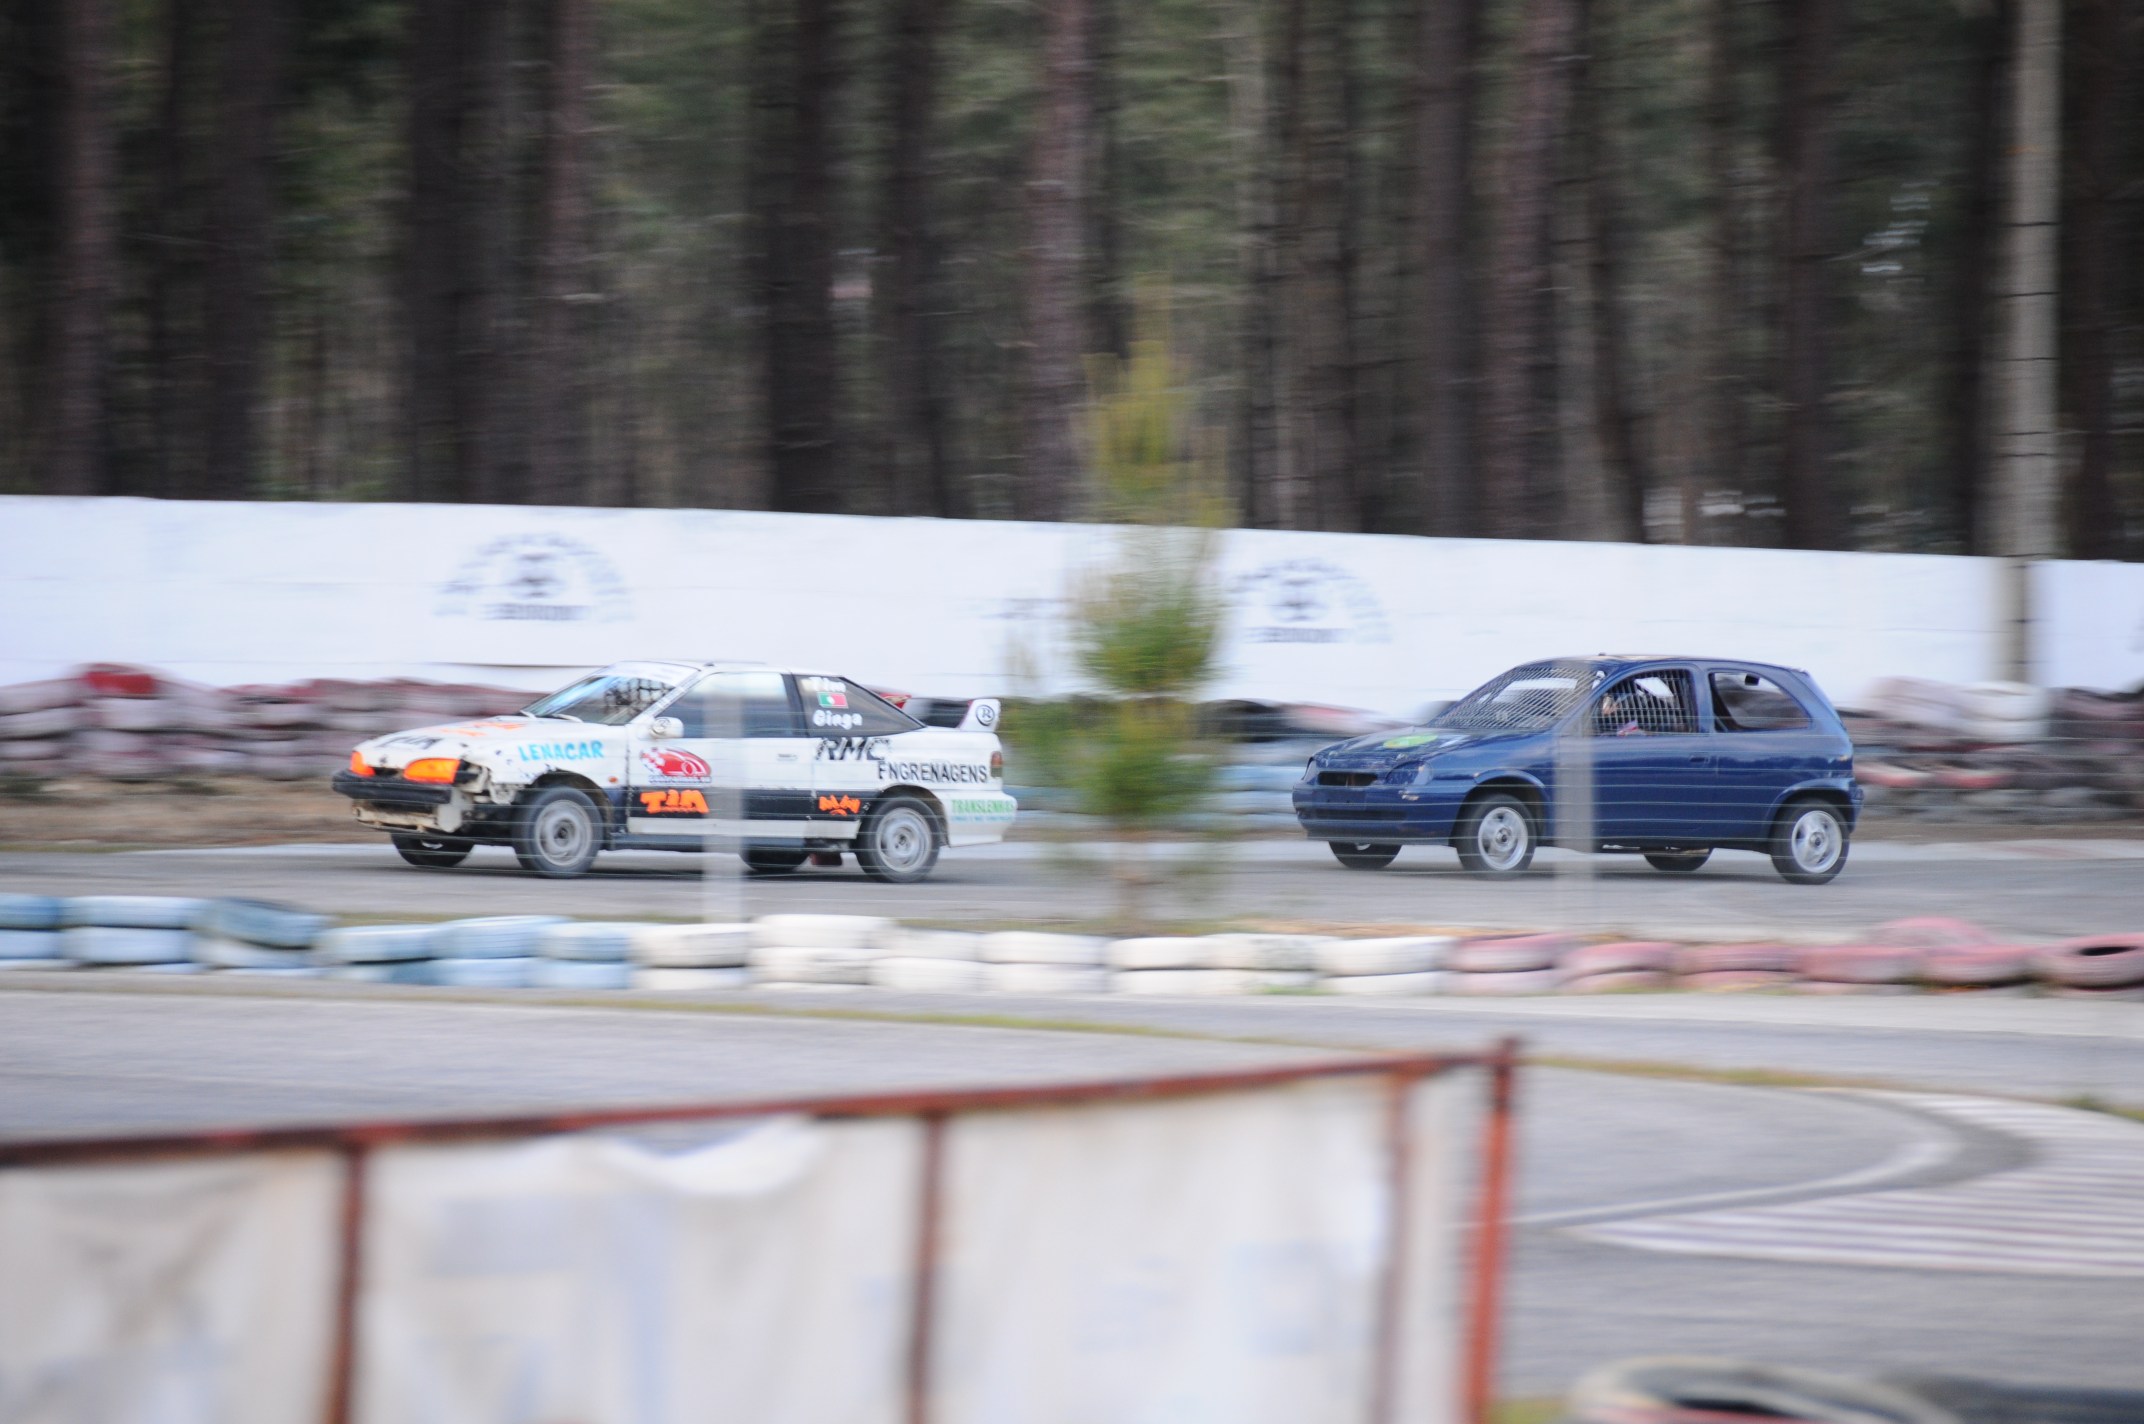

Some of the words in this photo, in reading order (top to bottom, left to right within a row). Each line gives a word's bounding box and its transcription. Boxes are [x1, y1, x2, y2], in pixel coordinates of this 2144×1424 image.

[813, 709, 862, 730] Ginga
[518, 740, 604, 762] LENACAR
[815, 737, 891, 760] RMC
[878, 761, 988, 783] ENGRENAGENS
